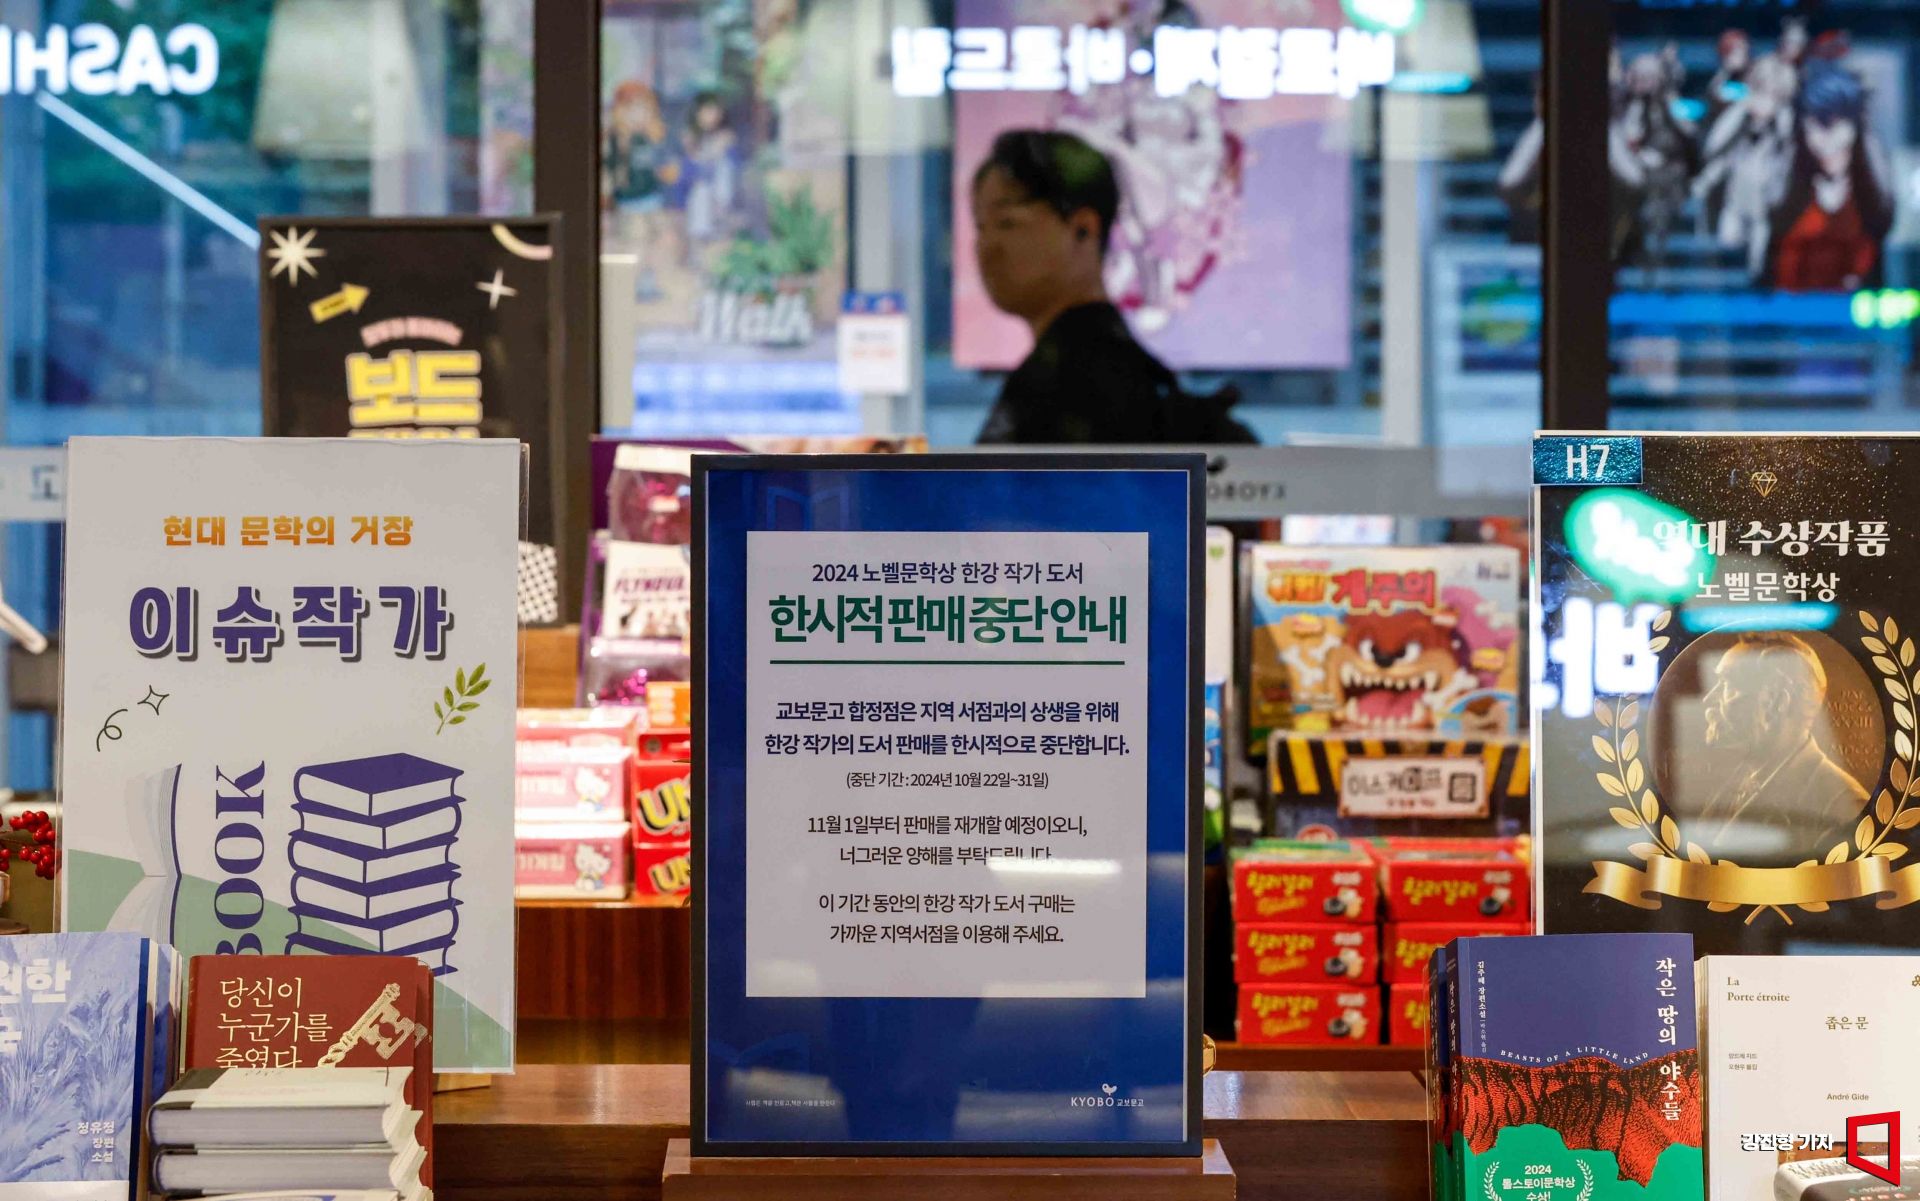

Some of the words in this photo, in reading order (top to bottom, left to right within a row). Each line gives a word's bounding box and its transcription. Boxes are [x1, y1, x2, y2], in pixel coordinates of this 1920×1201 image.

[345, 349, 483, 427] 보드
[1566, 445, 1611, 479] H7
[163, 515, 226, 546] 현대
[240, 515, 335, 546] 문학의
[350, 515, 413, 546] 거장
[1738, 520, 1891, 557] 수상작품
[812, 562, 859, 584] 2024
[861, 561, 957, 585] 노벨문학상
[961, 561, 999, 585] 한강
[1003, 561, 1042, 585] 작가
[1046, 561, 1083, 585] 도서
[1695, 571, 1840, 602] 노벨문학상
[130, 586, 454, 662] 이슈작가
[768, 594, 883, 645] 한시적
[887, 594, 966, 645] 판매
[968, 594, 1049, 645] 중단
[1050, 594, 1127, 645] 안내
[776, 701, 845, 722] 교보문고
[848, 701, 917, 723] 합정점은
[920, 701, 954, 723] 지역
[958, 701, 1026, 723] 서점과의
[1030, 701, 1082, 723] 상생을
[1085, 701, 1119, 723] 위해
[765, 734, 800, 755] 한강
[803, 734, 854, 755] 작가의
[858, 734, 892, 755] 도서
[896, 734, 948, 755] 판매를
[951, 734, 1037, 755] 한시적으로
[1040, 734, 1130, 755] 중단합니다.
[846, 772, 877, 789] (중단
[879, 772, 905, 789] 기간
[910, 772, 952, 789] 2024년
[955, 772, 981, 789] 10월
[983, 772, 1049, 789] 22일~31일)
[807, 815, 842, 835] 11월
[844, 815, 900, 836] 1일부터
[903, 815, 951, 836] 판매를
[954, 815, 1002, 836] 재개할
[1005, 815, 1088, 837] 예정이오니,
[840, 845, 904, 865] 너그러운
[906, 845, 954, 865] 양해를
[819, 894, 835, 913] 이
[838, 894, 870, 913] 기간
[873, 894, 920, 913] 동안의
[923, 894, 956, 914] 한강
[959, 894, 991, 913] 작가
[993, 894, 1025, 913] 도서
[1028, 894, 1076, 914] 구매는
[829, 924, 878, 943] 가까운
[880, 924, 959, 944] 지역서점을
[962, 924, 1010, 943] 이용해
[1012, 924, 1064, 943] 주세요.
[1655, 957, 1678, 997] 작은
[1727, 976, 1740, 986] La
[219, 977, 302, 1008] 당신이
[1727, 992, 1755, 1002] Porte
[1756, 991, 1791, 1002] étroite
[217, 1012, 333, 1043] 누군가를
[1657, 1004, 1679, 1046] 땅의
[1825, 1016, 1852, 1030] 좁은
[1855, 1016, 1869, 1030] 문
[1500, 1049, 1542, 1064] BEASTS
[1546, 1054, 1559, 1063] OF
[1577, 1046, 1619, 1060] LITTLE
[1623, 1051, 1649, 1064] LAND
[1071, 1096, 1115, 1107] KYOBO
[1659, 1060, 1683, 1121] 야수들
[1826, 1092, 1850, 1101] André
[1851, 1092, 1870, 1101] Gide
[78, 1120, 115, 1135] 정유정
[91, 1151, 113, 1163] 소설
[1524, 1164, 1552, 1175] 2024
